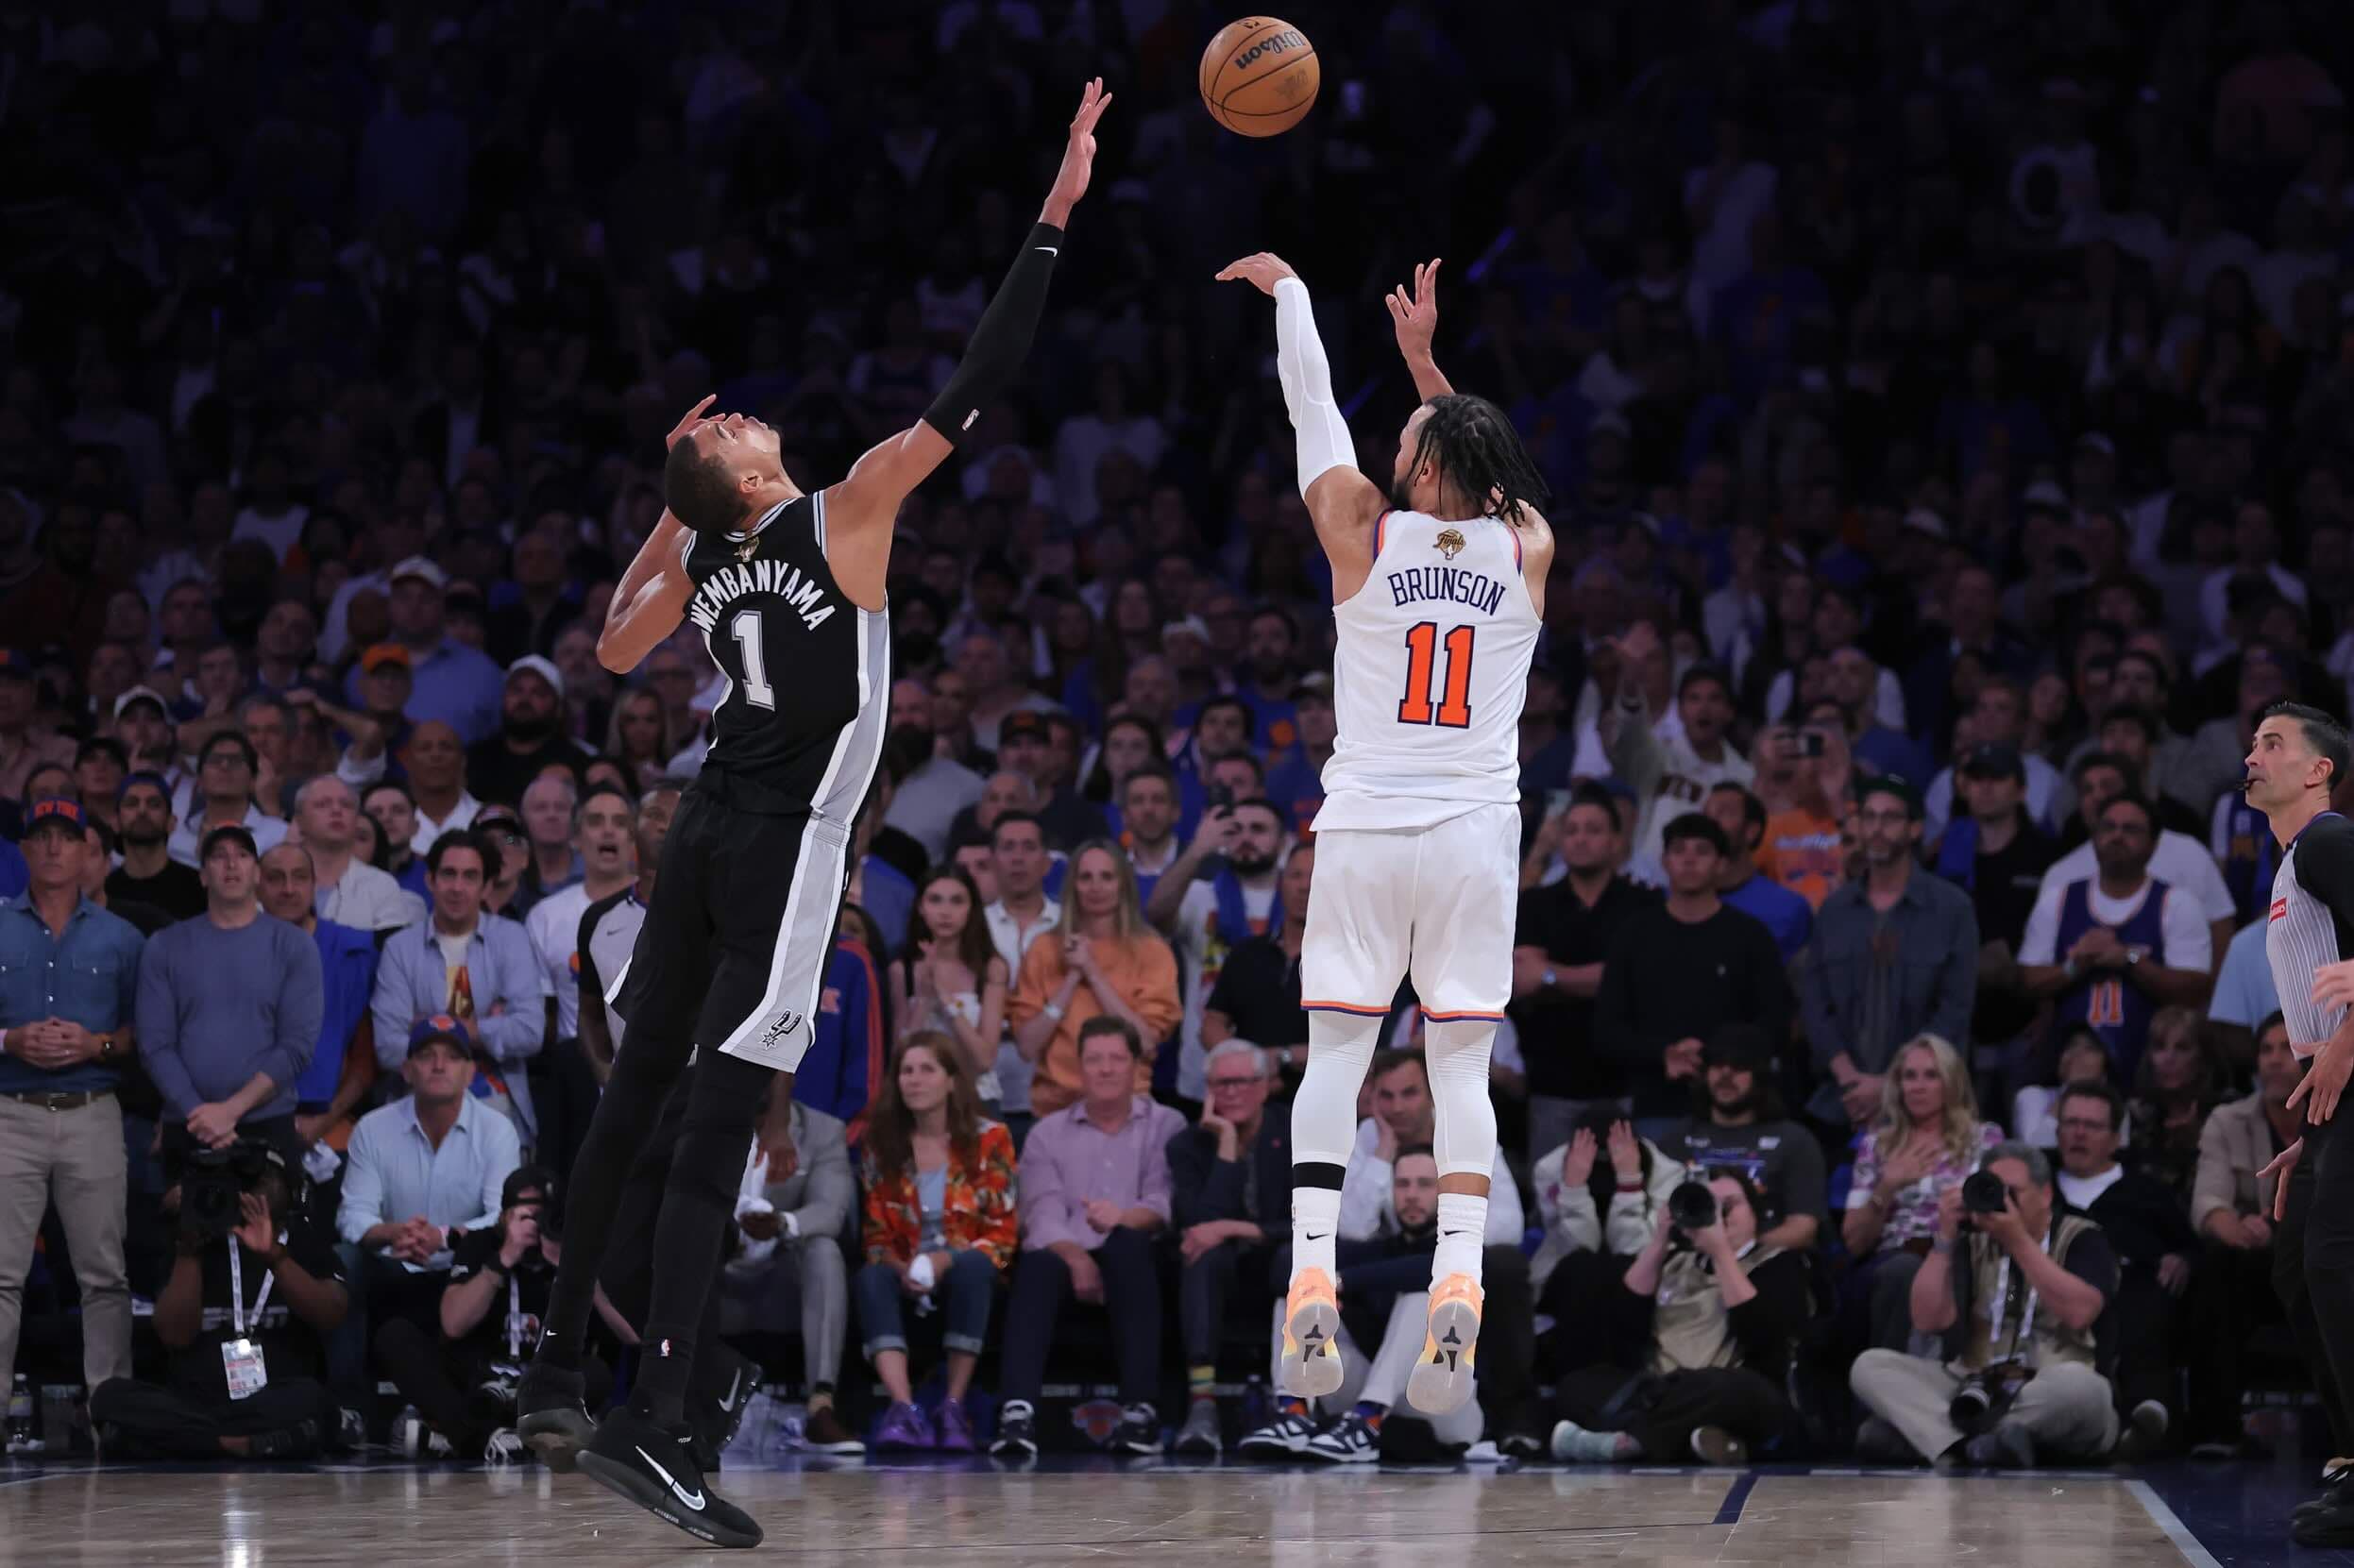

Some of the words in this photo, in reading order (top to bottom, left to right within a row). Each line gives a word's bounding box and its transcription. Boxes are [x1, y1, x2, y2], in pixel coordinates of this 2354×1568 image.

[1235, 30, 1306, 69] Wilson
[1433, 532, 1465, 548] Finals
[690, 560, 836, 633] WEMBANYAMA
[1388, 567, 1506, 615] BRUNSON
[731, 609, 775, 712] 1
[1397, 620, 1476, 730] 11
[34, 800, 55, 819] NEW
[56, 800, 79, 821] YORK
[2088, 981, 2124, 1026] 11
